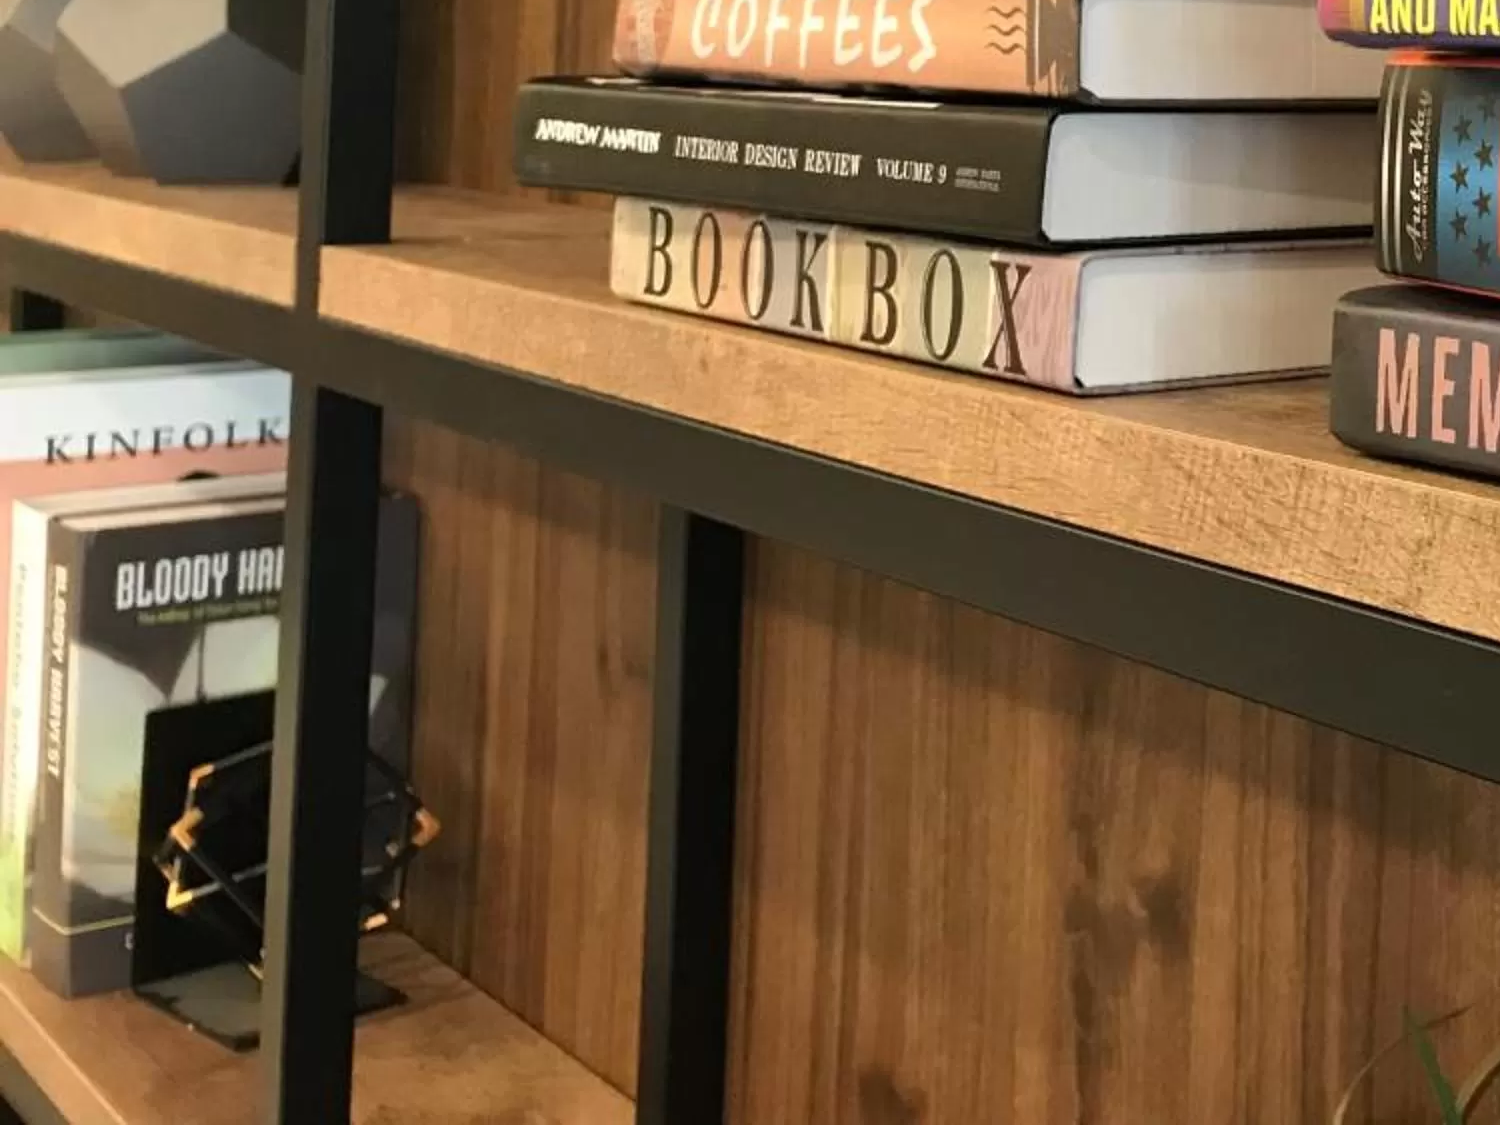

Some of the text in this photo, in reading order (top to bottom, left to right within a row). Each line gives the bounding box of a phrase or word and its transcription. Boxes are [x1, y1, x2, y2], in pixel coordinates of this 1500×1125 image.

[535, 118, 601, 146] ANDREW
[599, 126, 662, 154] MARTIN
[674, 135, 739, 164] INTERIOR
[744, 142, 799, 171] DESIGN
[804, 148, 863, 177] REVIEW
[876, 157, 935, 184] VOLUME
[937, 164, 947, 184] 9
[643, 206, 1033, 376] BOOK BOX
[44, 417, 284, 465] KINFOLK
[51, 564, 67, 663] BLOODY
[116, 550, 229, 611] BLOODY
